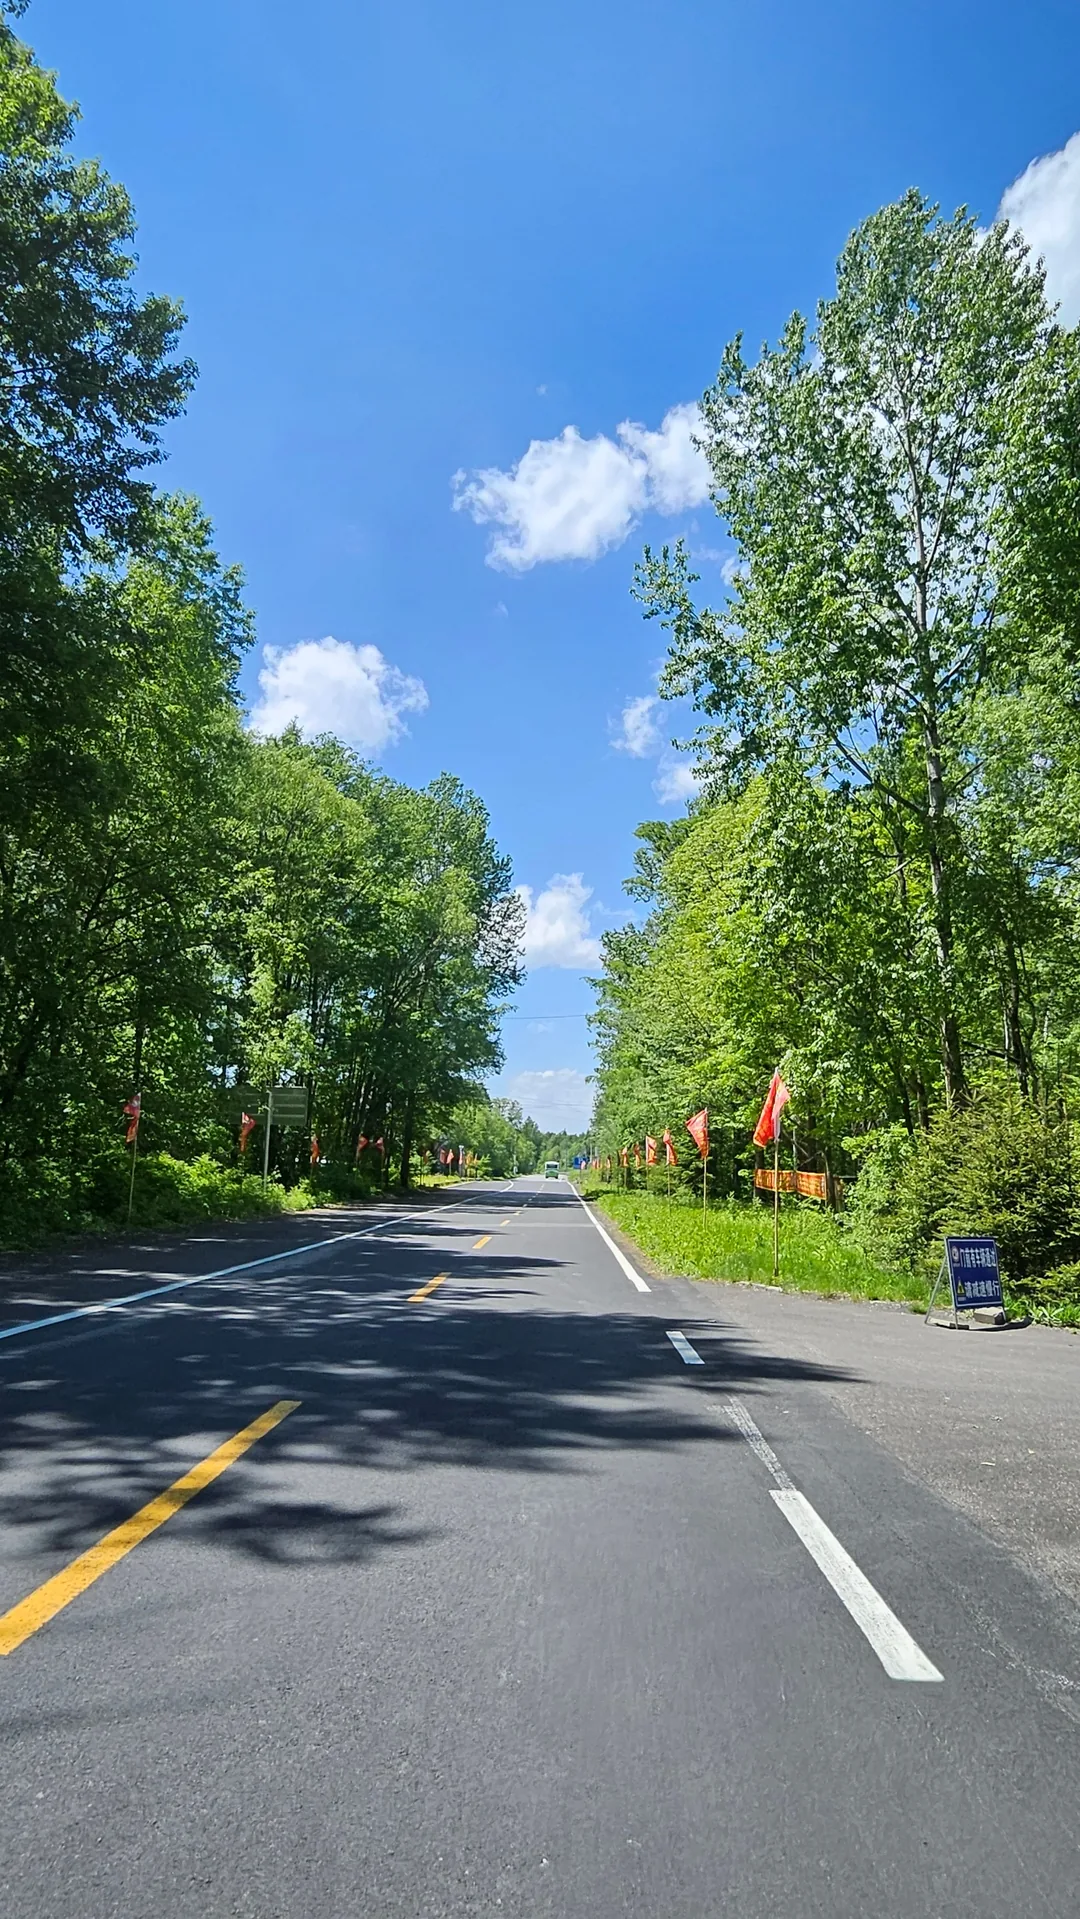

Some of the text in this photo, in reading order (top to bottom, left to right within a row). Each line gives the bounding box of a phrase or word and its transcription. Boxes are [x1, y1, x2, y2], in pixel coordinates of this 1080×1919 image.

[964, 1280, 1000, 1298] 请减速慢行
